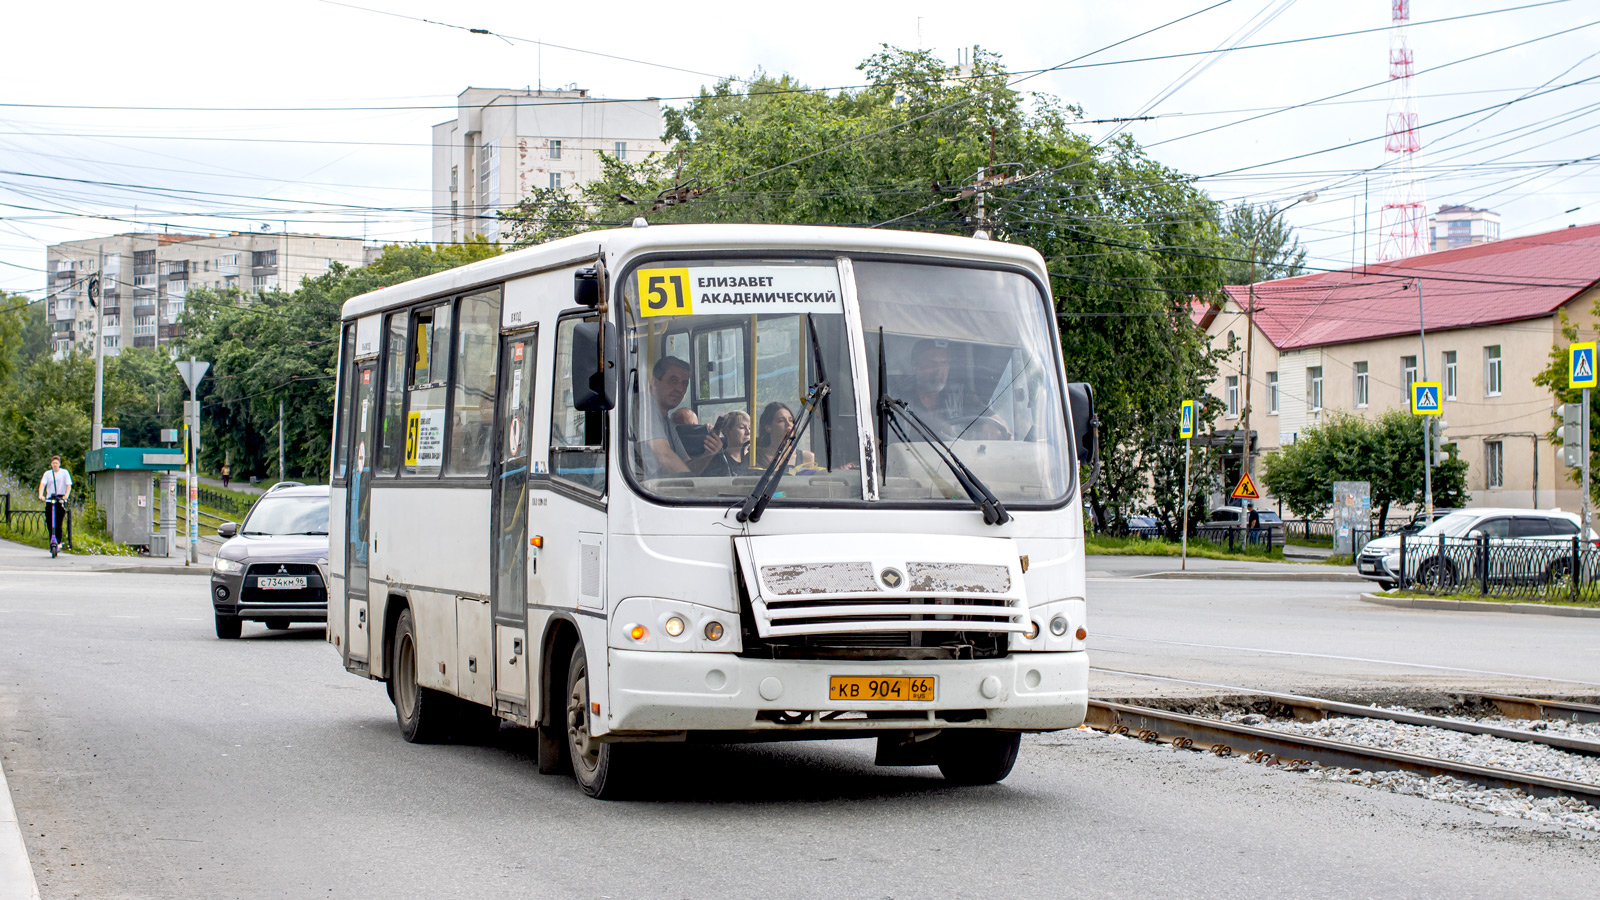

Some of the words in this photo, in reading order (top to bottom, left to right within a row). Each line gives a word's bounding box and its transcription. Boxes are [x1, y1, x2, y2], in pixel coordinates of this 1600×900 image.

[697, 276, 774, 288] ЕЛИЗАВЕТ
[647, 275, 685, 310] 51
[700, 290, 837, 305] АКАДЕМИЧЕСКИЙ
[406, 417, 419, 460] 51
[839, 683, 860, 697] КВ
[868, 680, 901, 698] 904
[911, 679, 928, 693] 66
